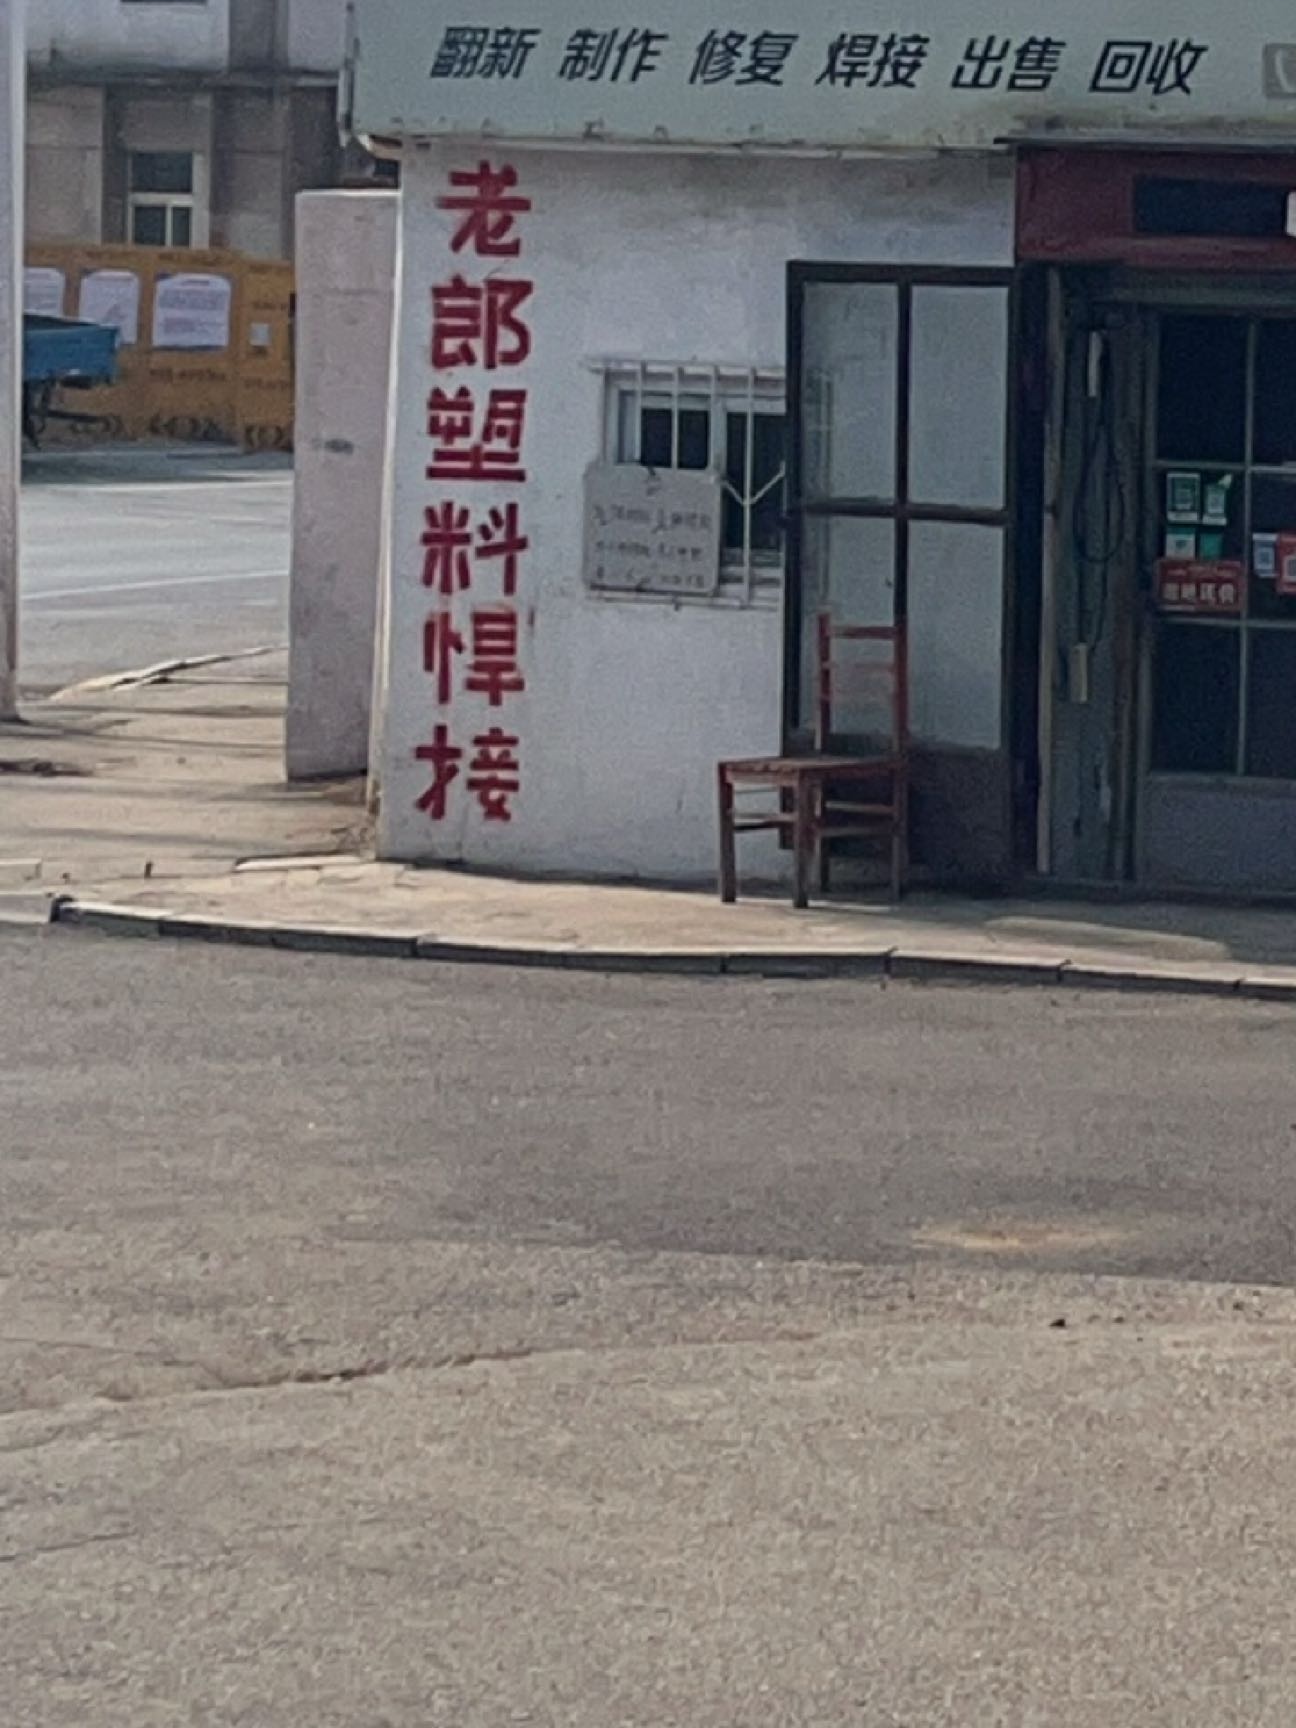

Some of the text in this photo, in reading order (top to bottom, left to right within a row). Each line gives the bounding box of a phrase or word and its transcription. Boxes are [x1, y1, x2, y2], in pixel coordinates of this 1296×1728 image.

[430, 26, 1208, 96] 翻新 制作 修复 焊接 出售 回收
